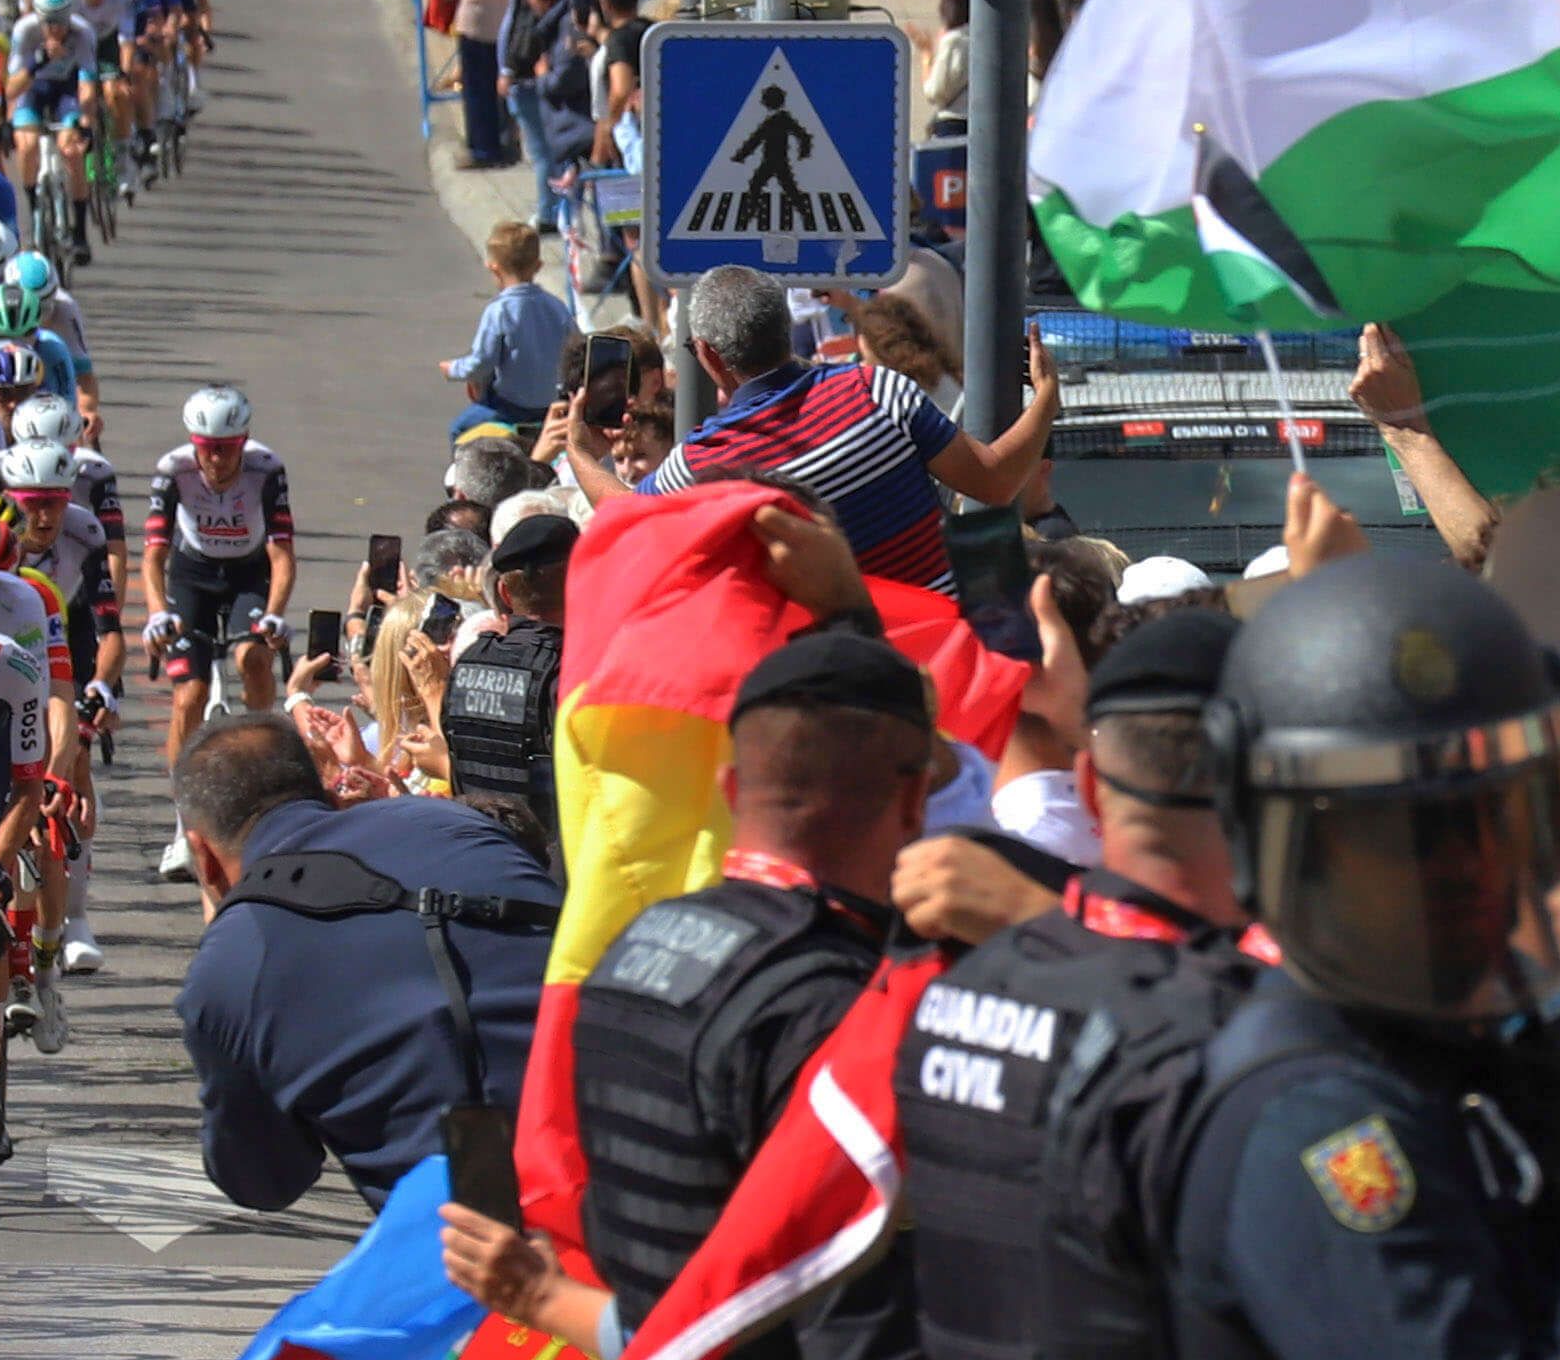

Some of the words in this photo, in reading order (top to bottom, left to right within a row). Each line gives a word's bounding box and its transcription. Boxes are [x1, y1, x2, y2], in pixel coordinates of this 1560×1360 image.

[943, 175, 964, 203] P
[455, 667, 525, 697] GUARDIA
[465, 689, 506, 717] CIVIL
[20, 697, 38, 752] BOSS
[915, 982, 1057, 1063] GUARDIA
[919, 1043, 1007, 1114] CIVIL
